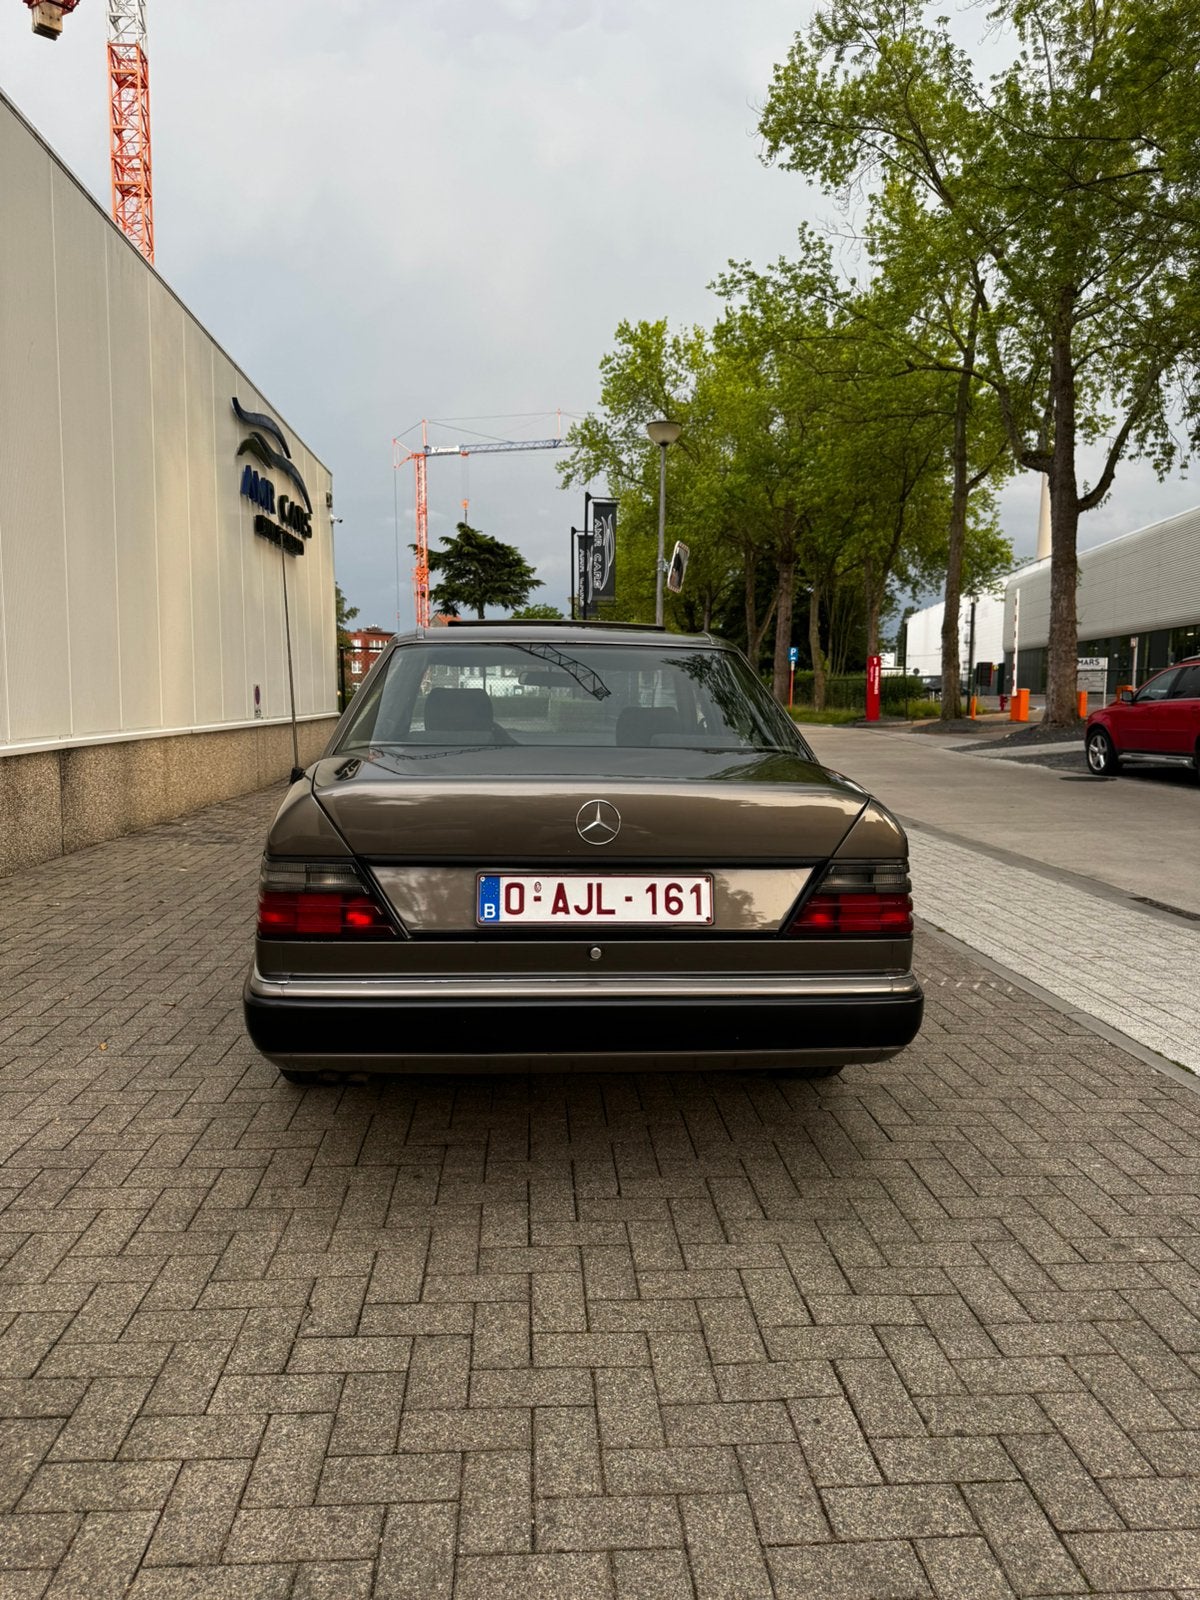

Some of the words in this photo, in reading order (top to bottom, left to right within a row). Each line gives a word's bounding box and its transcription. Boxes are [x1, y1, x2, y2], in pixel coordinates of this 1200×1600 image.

[594, 518, 602, 547] AMR
[594, 553, 602, 589] CARS
[790, 647, 797, 656] P
[484, 903, 496, 918] B
